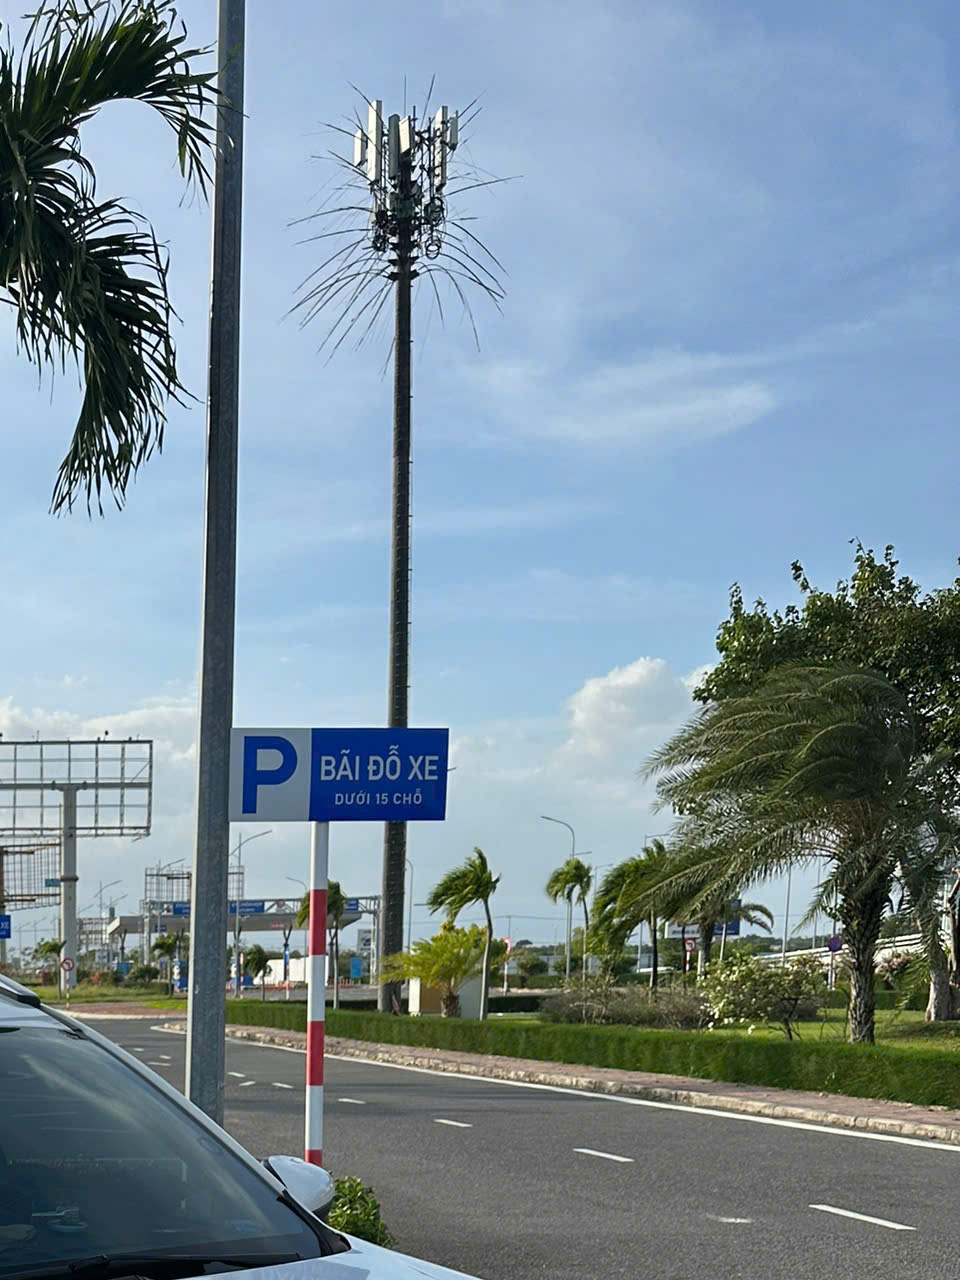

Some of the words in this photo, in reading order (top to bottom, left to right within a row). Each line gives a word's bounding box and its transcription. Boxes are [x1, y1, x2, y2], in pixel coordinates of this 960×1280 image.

[242, 736, 297, 814] P
[320, 749, 360, 781] BÃI
[367, 744, 401, 781] ĐỖ
[407, 756, 439, 781] XE
[335, 792, 370, 805] DƯỚI
[376, 793, 389, 805] 15
[393, 788, 422, 805] CHỖ
